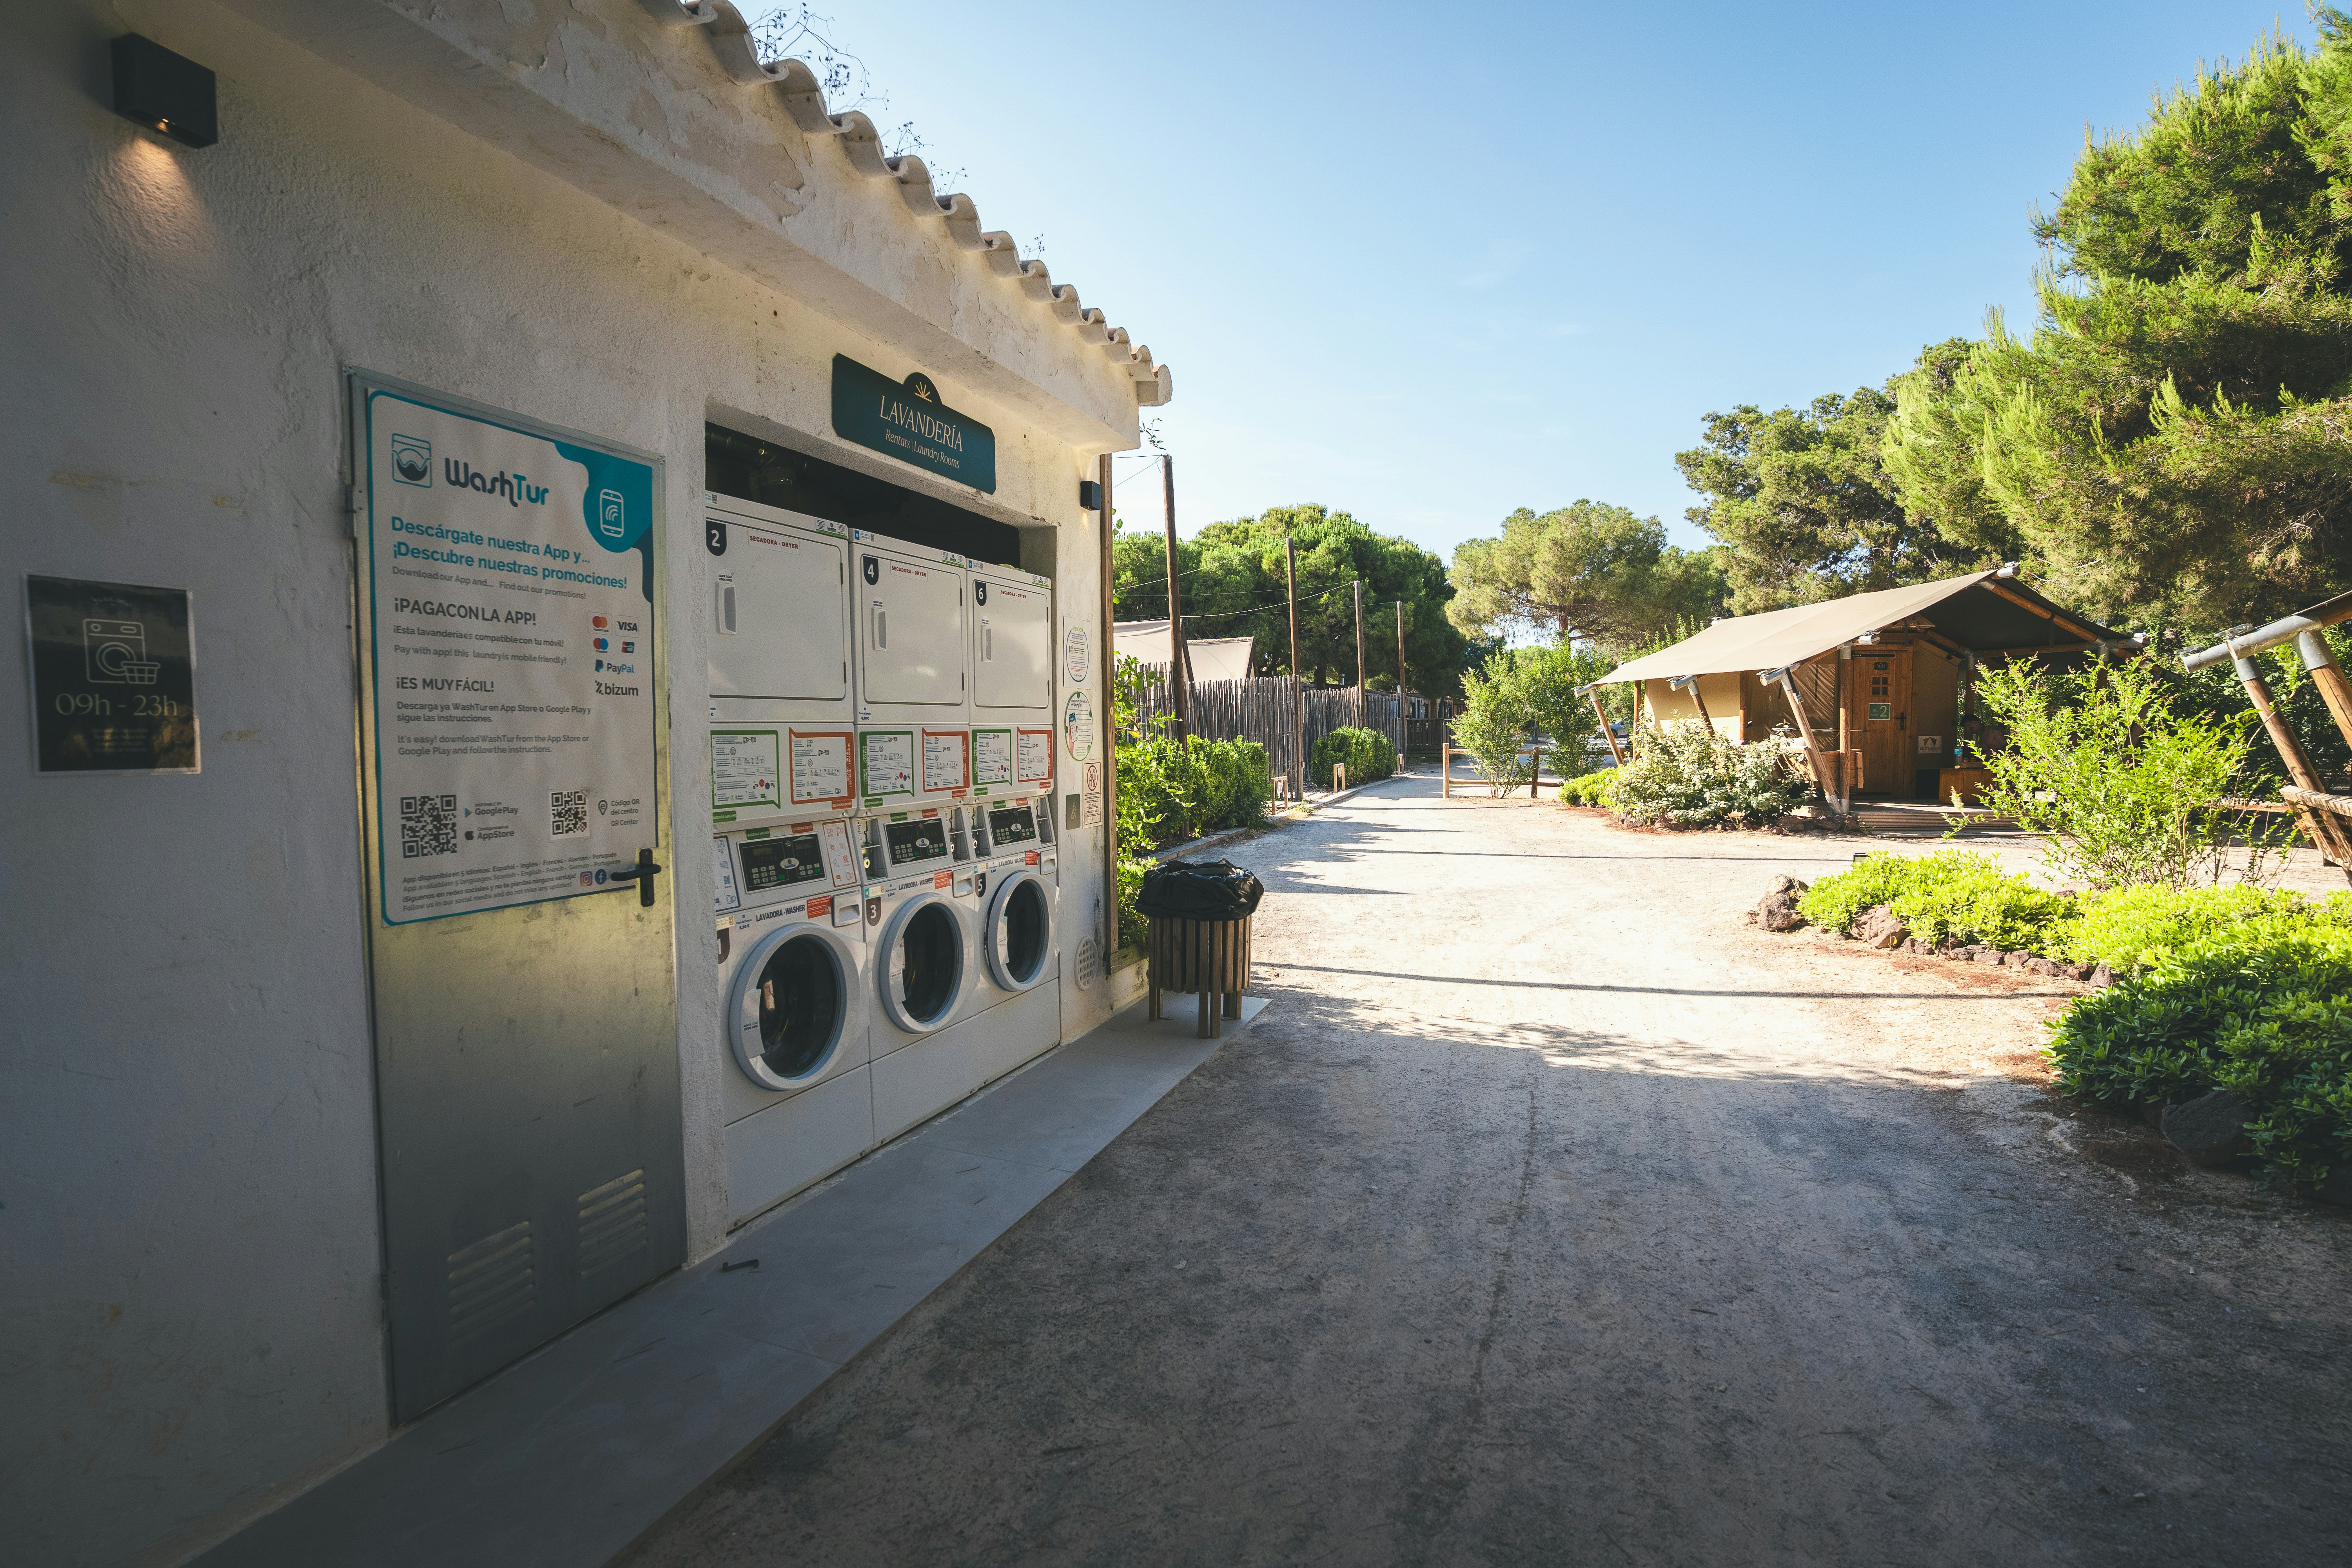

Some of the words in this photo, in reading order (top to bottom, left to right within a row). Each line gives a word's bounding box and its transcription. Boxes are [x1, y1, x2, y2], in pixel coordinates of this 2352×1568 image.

[880, 395, 962, 452] LAVANDERÍA
[886, 429, 910, 449] Rentats
[914, 441, 939, 462] Laundry
[940, 452, 960, 469] Rooms
[445, 457, 549, 508] WashTur
[392, 516, 484, 545] Descárgate
[488, 536, 540, 555] nuestra
[543, 543, 570, 562] App
[711, 530, 720, 547] 2
[750, 535, 777, 546] SECADORA
[393, 541, 475, 567] ¡Descubre
[478, 557, 538, 576] nuestras
[542, 567, 627, 589] promociones!
[867, 564, 874, 578] 4
[891, 566, 911, 574] SECADORA
[455, 575, 471, 586] App
[499, 581, 515, 590] Find
[544, 588, 586, 599] promotions!
[979, 588, 984, 600] 6
[482, 607, 501, 622] LA
[504, 610, 536, 626] APP!
[617, 621, 638, 632] VISA
[475, 634, 518, 643] compatible
[394, 644, 410, 655] Pay
[412, 646, 431, 655] with
[454, 648, 469, 657] this
[606, 662, 635, 675] PayPal
[396, 677, 418, 690] ¡ES
[422, 678, 454, 691] MUY
[456, 677, 494, 692] FÁCIL!
[604, 683, 639, 696] bizum
[55, 693, 111, 715] 09h
[132, 695, 178, 716] 23h
[397, 701, 438, 712] Descarga
[452, 702, 487, 711] WashTur
[500, 704, 516, 713] App
[546, 705, 570, 714] Google
[571, 706, 586, 714] Play
[397, 713, 421, 723] sigue
[1880, 706, 1887, 717] 2
[547, 735, 561, 744] App
[398, 746, 430, 757] Google
[432, 746, 451, 756] Play
[475, 807, 502, 816] Google
[503, 806, 519, 815] Play
[477, 832, 493, 841] App
[899, 881, 918, 891] LAVADORA
[920, 877, 934, 886] WASHER
[978, 879, 982, 891] 5
[756, 909, 783, 922] LAVADORA
[785, 904, 806, 915] WASHER
[870, 904, 877, 919] 3
